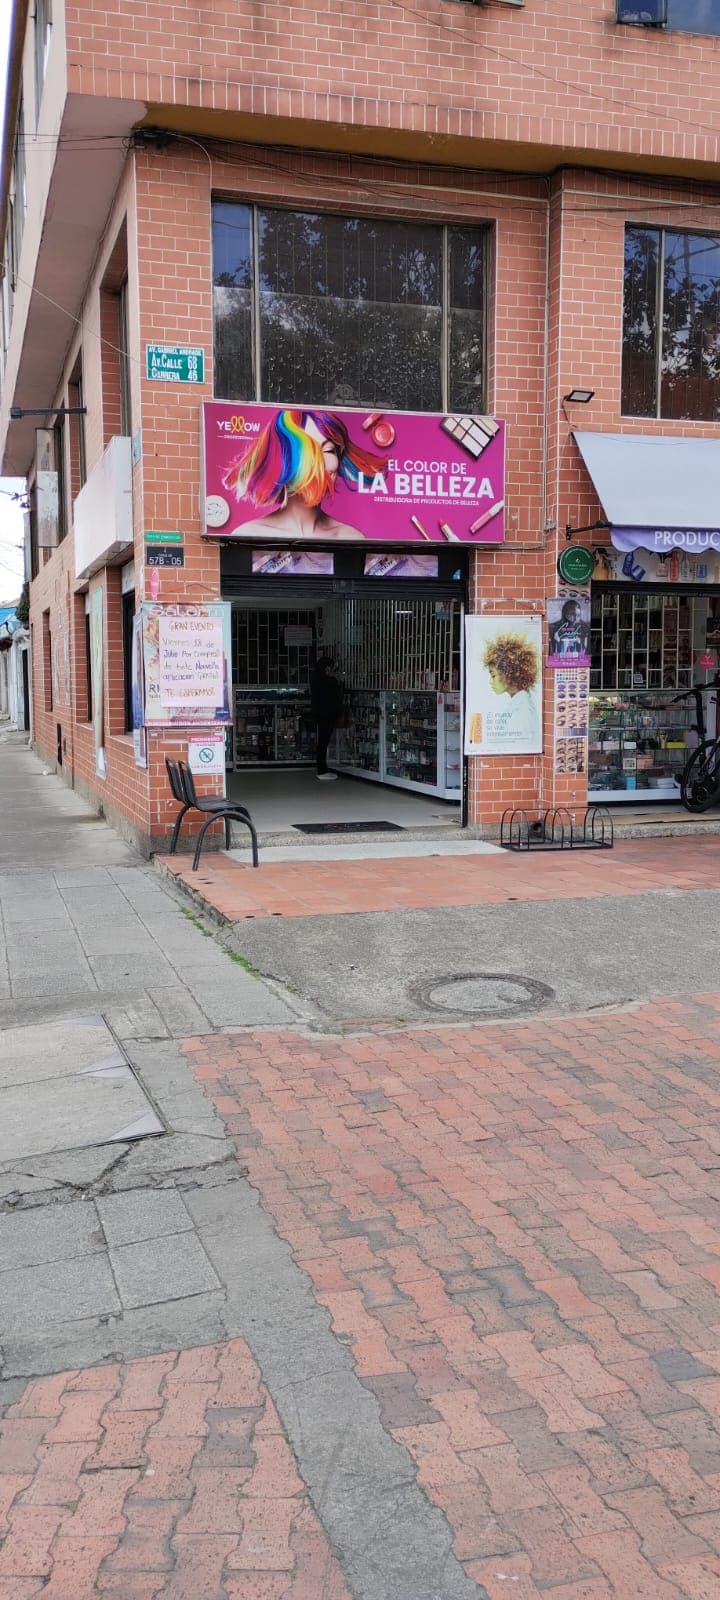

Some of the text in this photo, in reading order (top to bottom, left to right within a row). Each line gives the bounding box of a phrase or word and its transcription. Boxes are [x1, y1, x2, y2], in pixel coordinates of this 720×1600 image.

[187, 355, 198, 370] 68
[187, 369, 198, 381] 46
[388, 459, 467, 475] EL COLOR DE
[358, 471, 495, 499] LA BELLEZA
[654, 531, 720, 546] PRODUC
[148, 556, 165, 565] 57B
[171, 556, 182, 566] 05
[168, 621, 188, 632] GRAN
